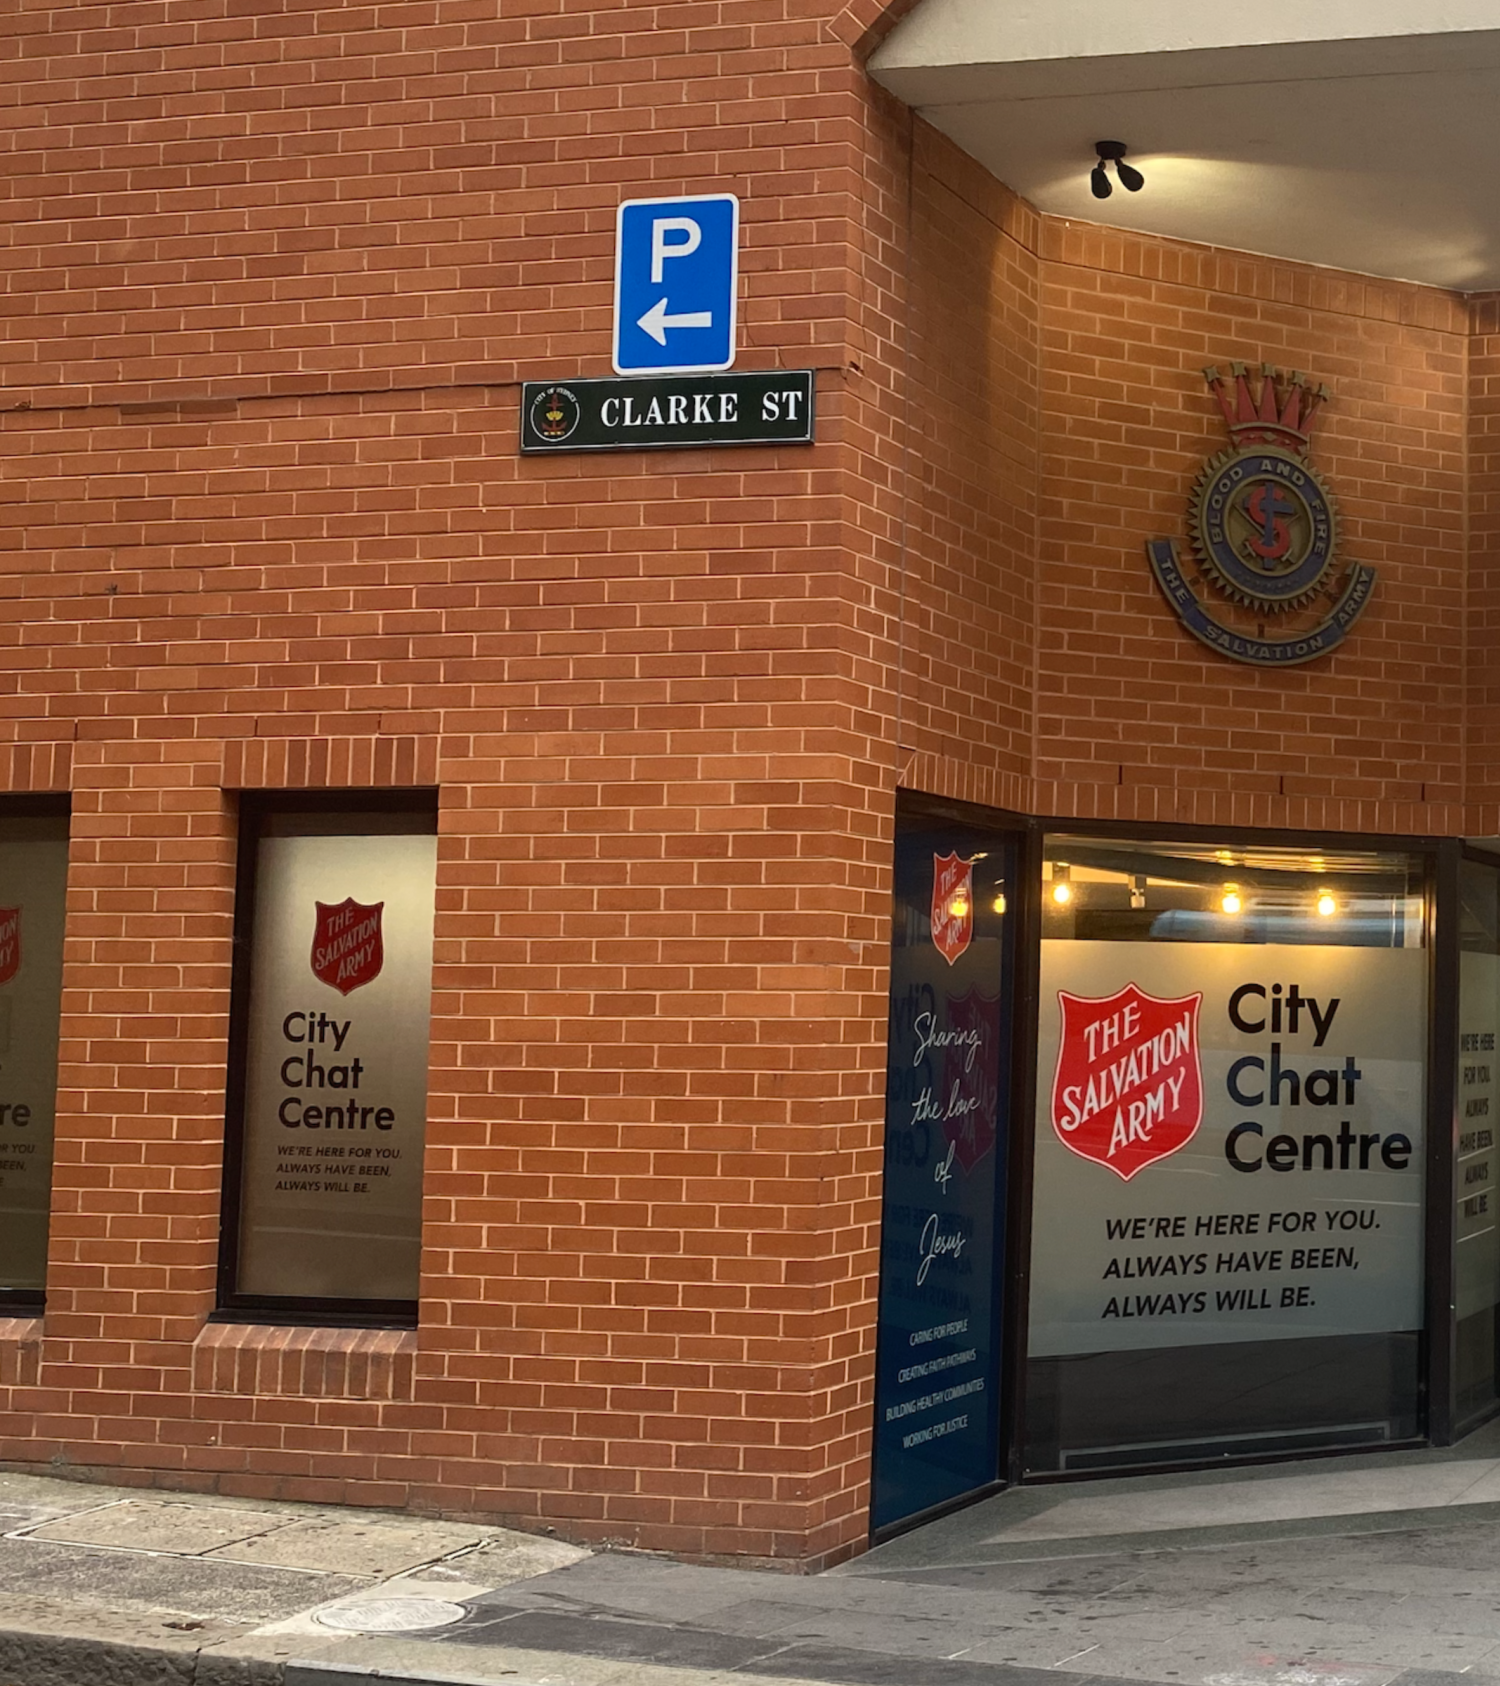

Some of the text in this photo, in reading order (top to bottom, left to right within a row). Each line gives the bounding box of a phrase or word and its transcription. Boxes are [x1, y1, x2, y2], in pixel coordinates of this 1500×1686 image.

[650, 216, 702, 284] P
[601, 391, 803, 427] CLARKE ST
[1210, 459, 1330, 556] BLOOD AND FIRE
[1160, 557, 1372, 660] THE SALVATION ARMY
[941, 861, 957, 896] THE
[315, 911, 378, 971] SALVATION
[326, 906, 355, 938] THE
[336, 939, 375, 984] ARMY
[282, 1010, 352, 1052] City
[1083, 1000, 1143, 1064] THE
[1227, 982, 1341, 1047] City
[913, 1011, 983, 1074] Sharing
[279, 1048, 364, 1089] Chat
[1059, 1011, 1190, 1132] SALVATION
[1225, 1042, 1363, 1108] Chat
[1463, 1066, 1476, 1085] FOR
[278, 1097, 396, 1131] Centre
[911, 1078, 981, 1125] the love
[1106, 1066, 1186, 1159] ARMY
[315, 1146, 346, 1157] HERE
[348, 1147, 373, 1158] FOR
[933, 1139, 956, 1195] of
[1224, 1120, 1413, 1173] Centre
[275, 1163, 392, 1177] ALWAYS HAVE BEEN,
[275, 1181, 321, 1192] ALWAYS
[323, 1182, 350, 1193] WILL
[1104, 1208, 1382, 1241] WE'RE HERE FOR YOU.
[916, 1213, 967, 1287] Jesus
[1102, 1246, 1361, 1280] ALWAYS HAVE BEEN,
[1101, 1286, 1317, 1319] ALWAYS WILL BE.
[909, 1319, 968, 1347] CARING FOR PEOPLE
[898, 1362, 929, 1384] CREATING
[885, 1399, 916, 1422] BUILDING
[902, 1414, 968, 1449] WORKING FOR JUSTICE
